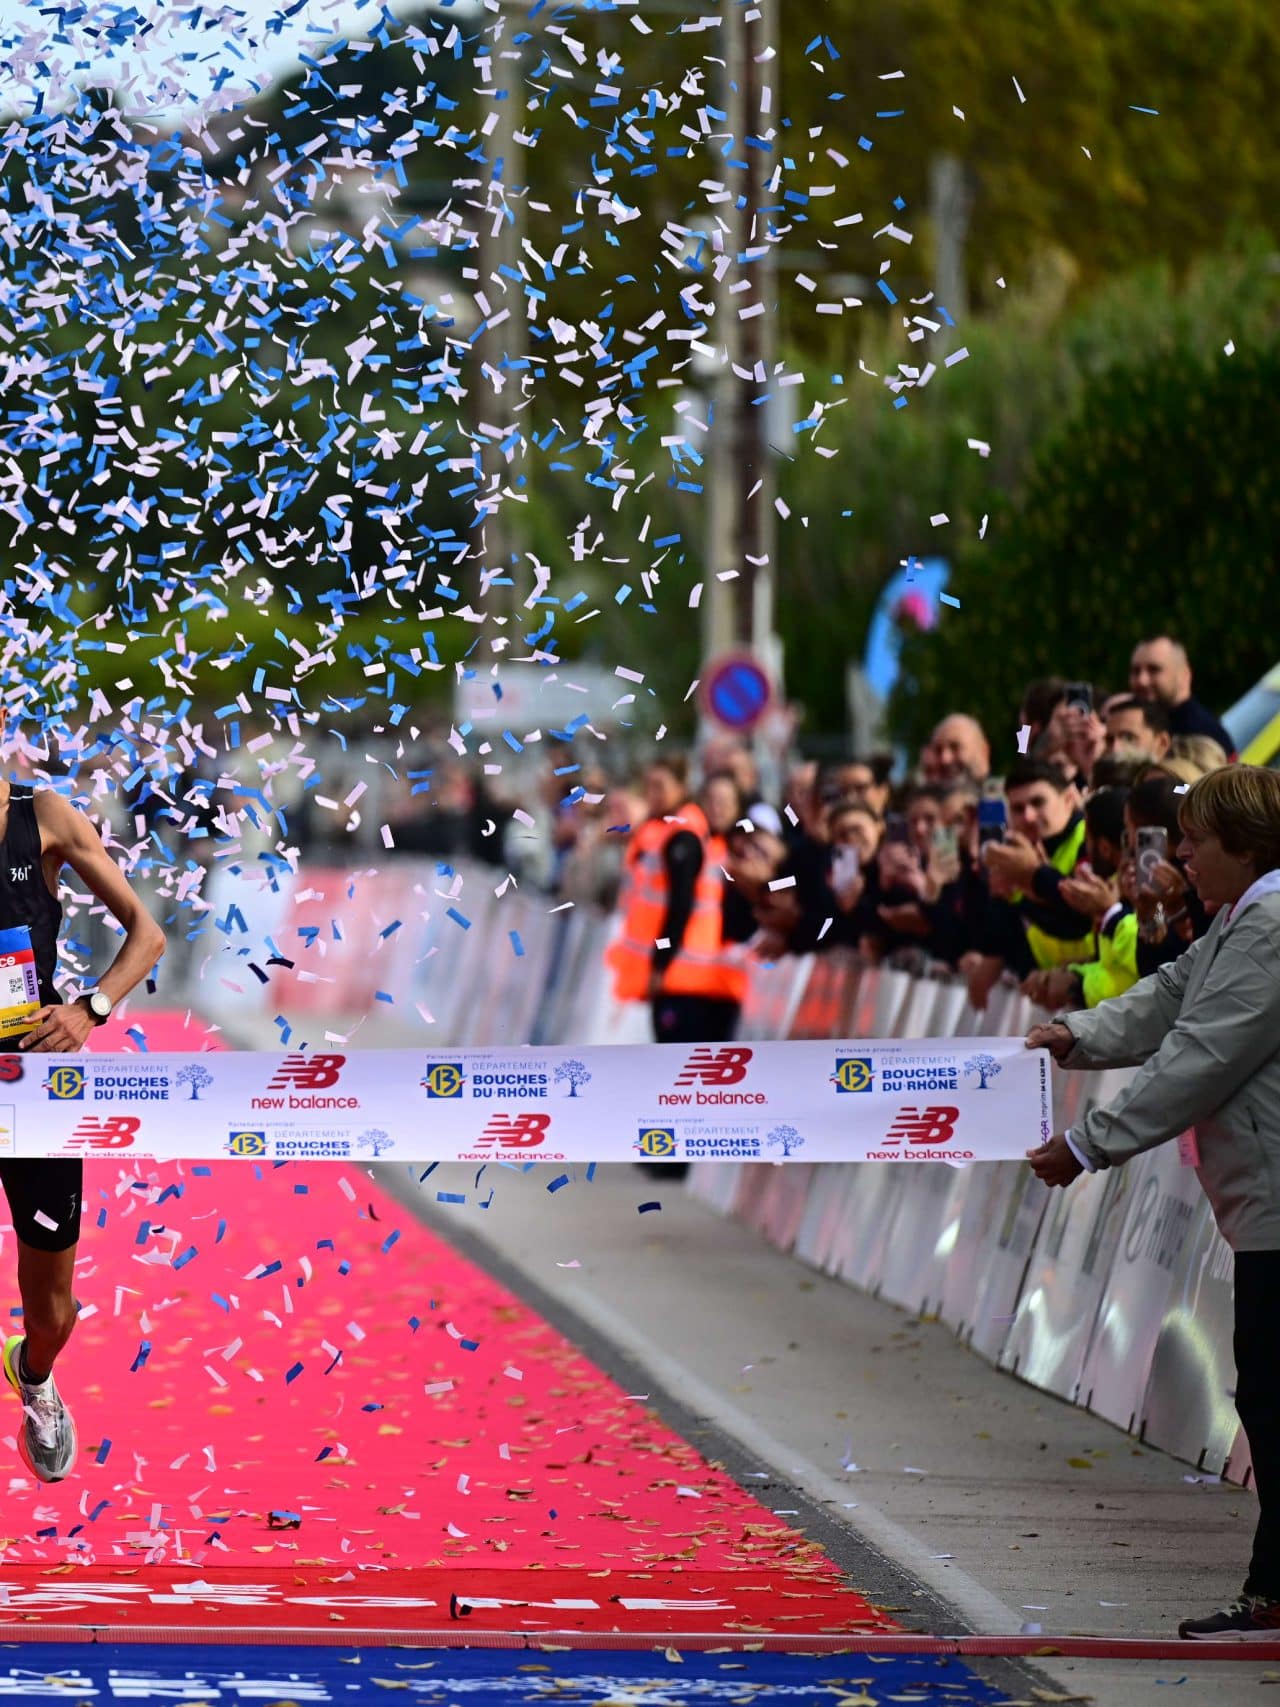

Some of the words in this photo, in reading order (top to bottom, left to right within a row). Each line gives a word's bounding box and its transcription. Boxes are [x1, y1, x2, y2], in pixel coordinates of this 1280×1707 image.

[27, 969, 36, 996] ELITES
[881, 1055, 956, 1065] DÉPARTEMENT
[93, 1063, 169, 1073] DÉPARTEMENT
[472, 1061, 547, 1070] DÉPARTEMENT
[251, 1097, 285, 1109] new
[289, 1096, 357, 1109] balance
[658, 1093, 692, 1105] new
[696, 1091, 765, 1105] balance
[458, 1152, 491, 1160] new
[866, 1151, 900, 1160] new
